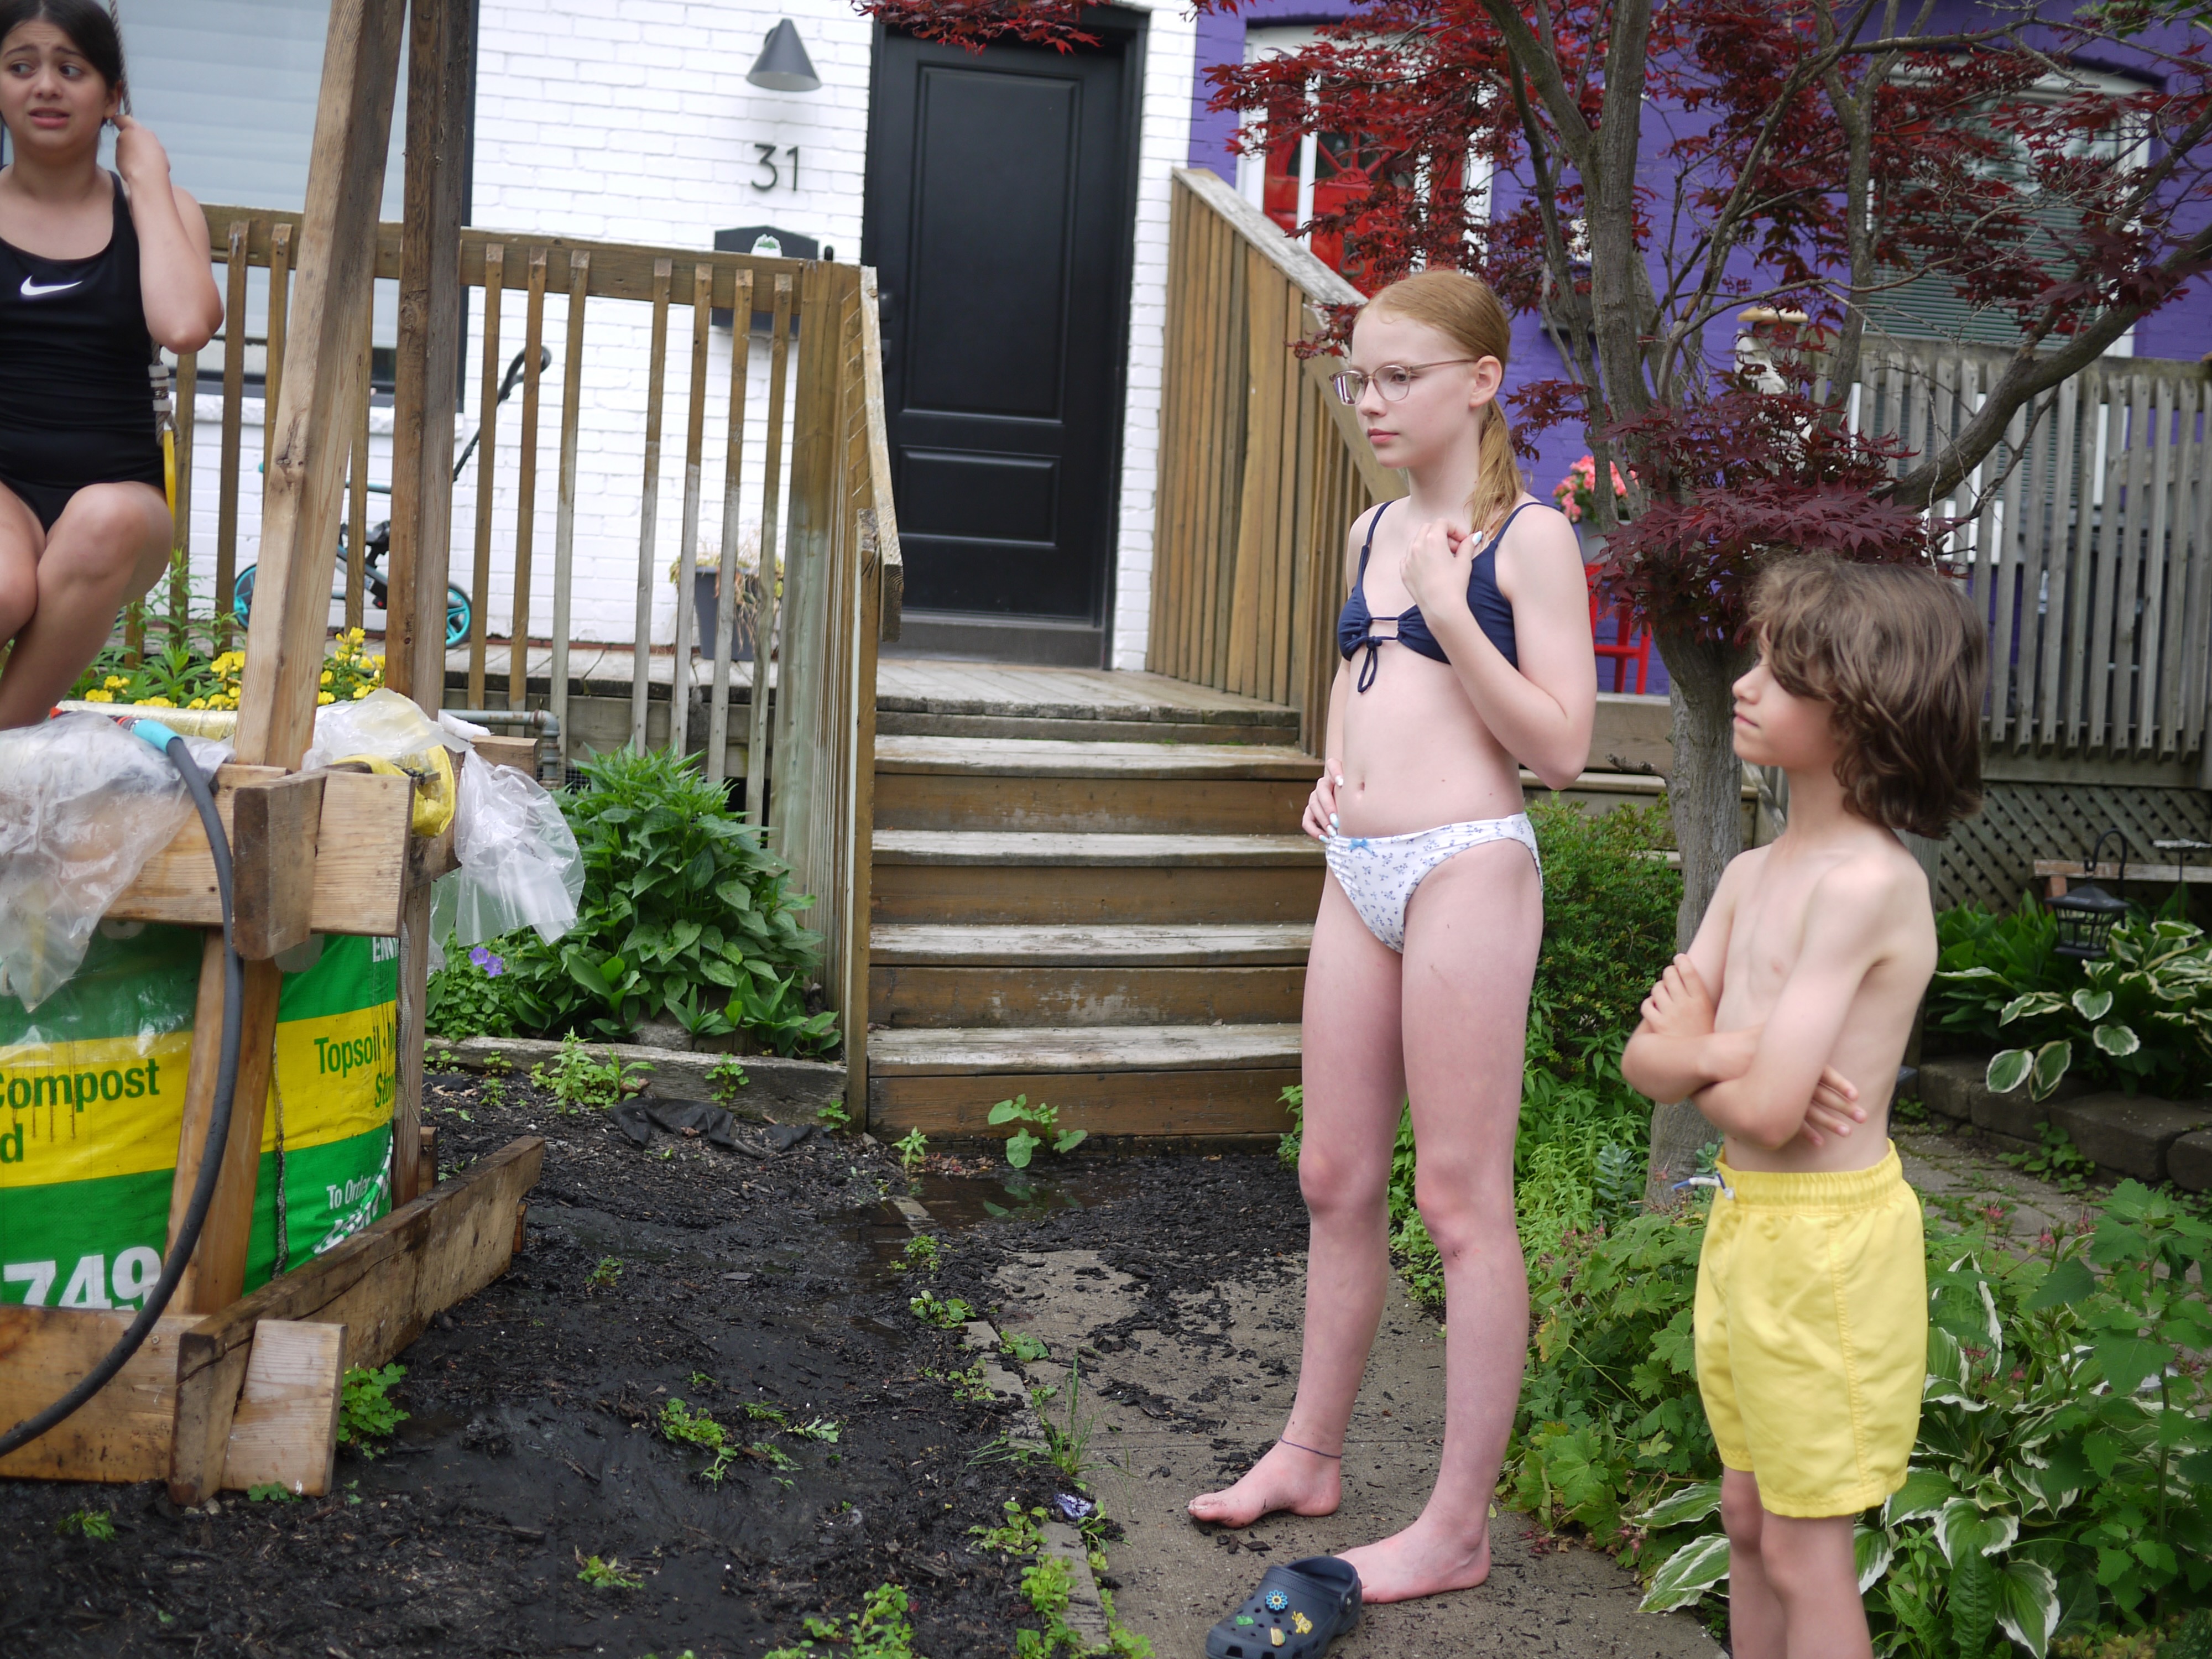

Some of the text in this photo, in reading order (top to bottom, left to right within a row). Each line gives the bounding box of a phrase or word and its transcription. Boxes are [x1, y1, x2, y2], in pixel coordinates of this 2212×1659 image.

[751, 143, 799, 191] 31
[314, 1025, 380, 1078] Topsoil
[0, 1058, 160, 1113] ompost
[326, 1175, 371, 1210] To Order
[3, 1246, 162, 1311] 749
